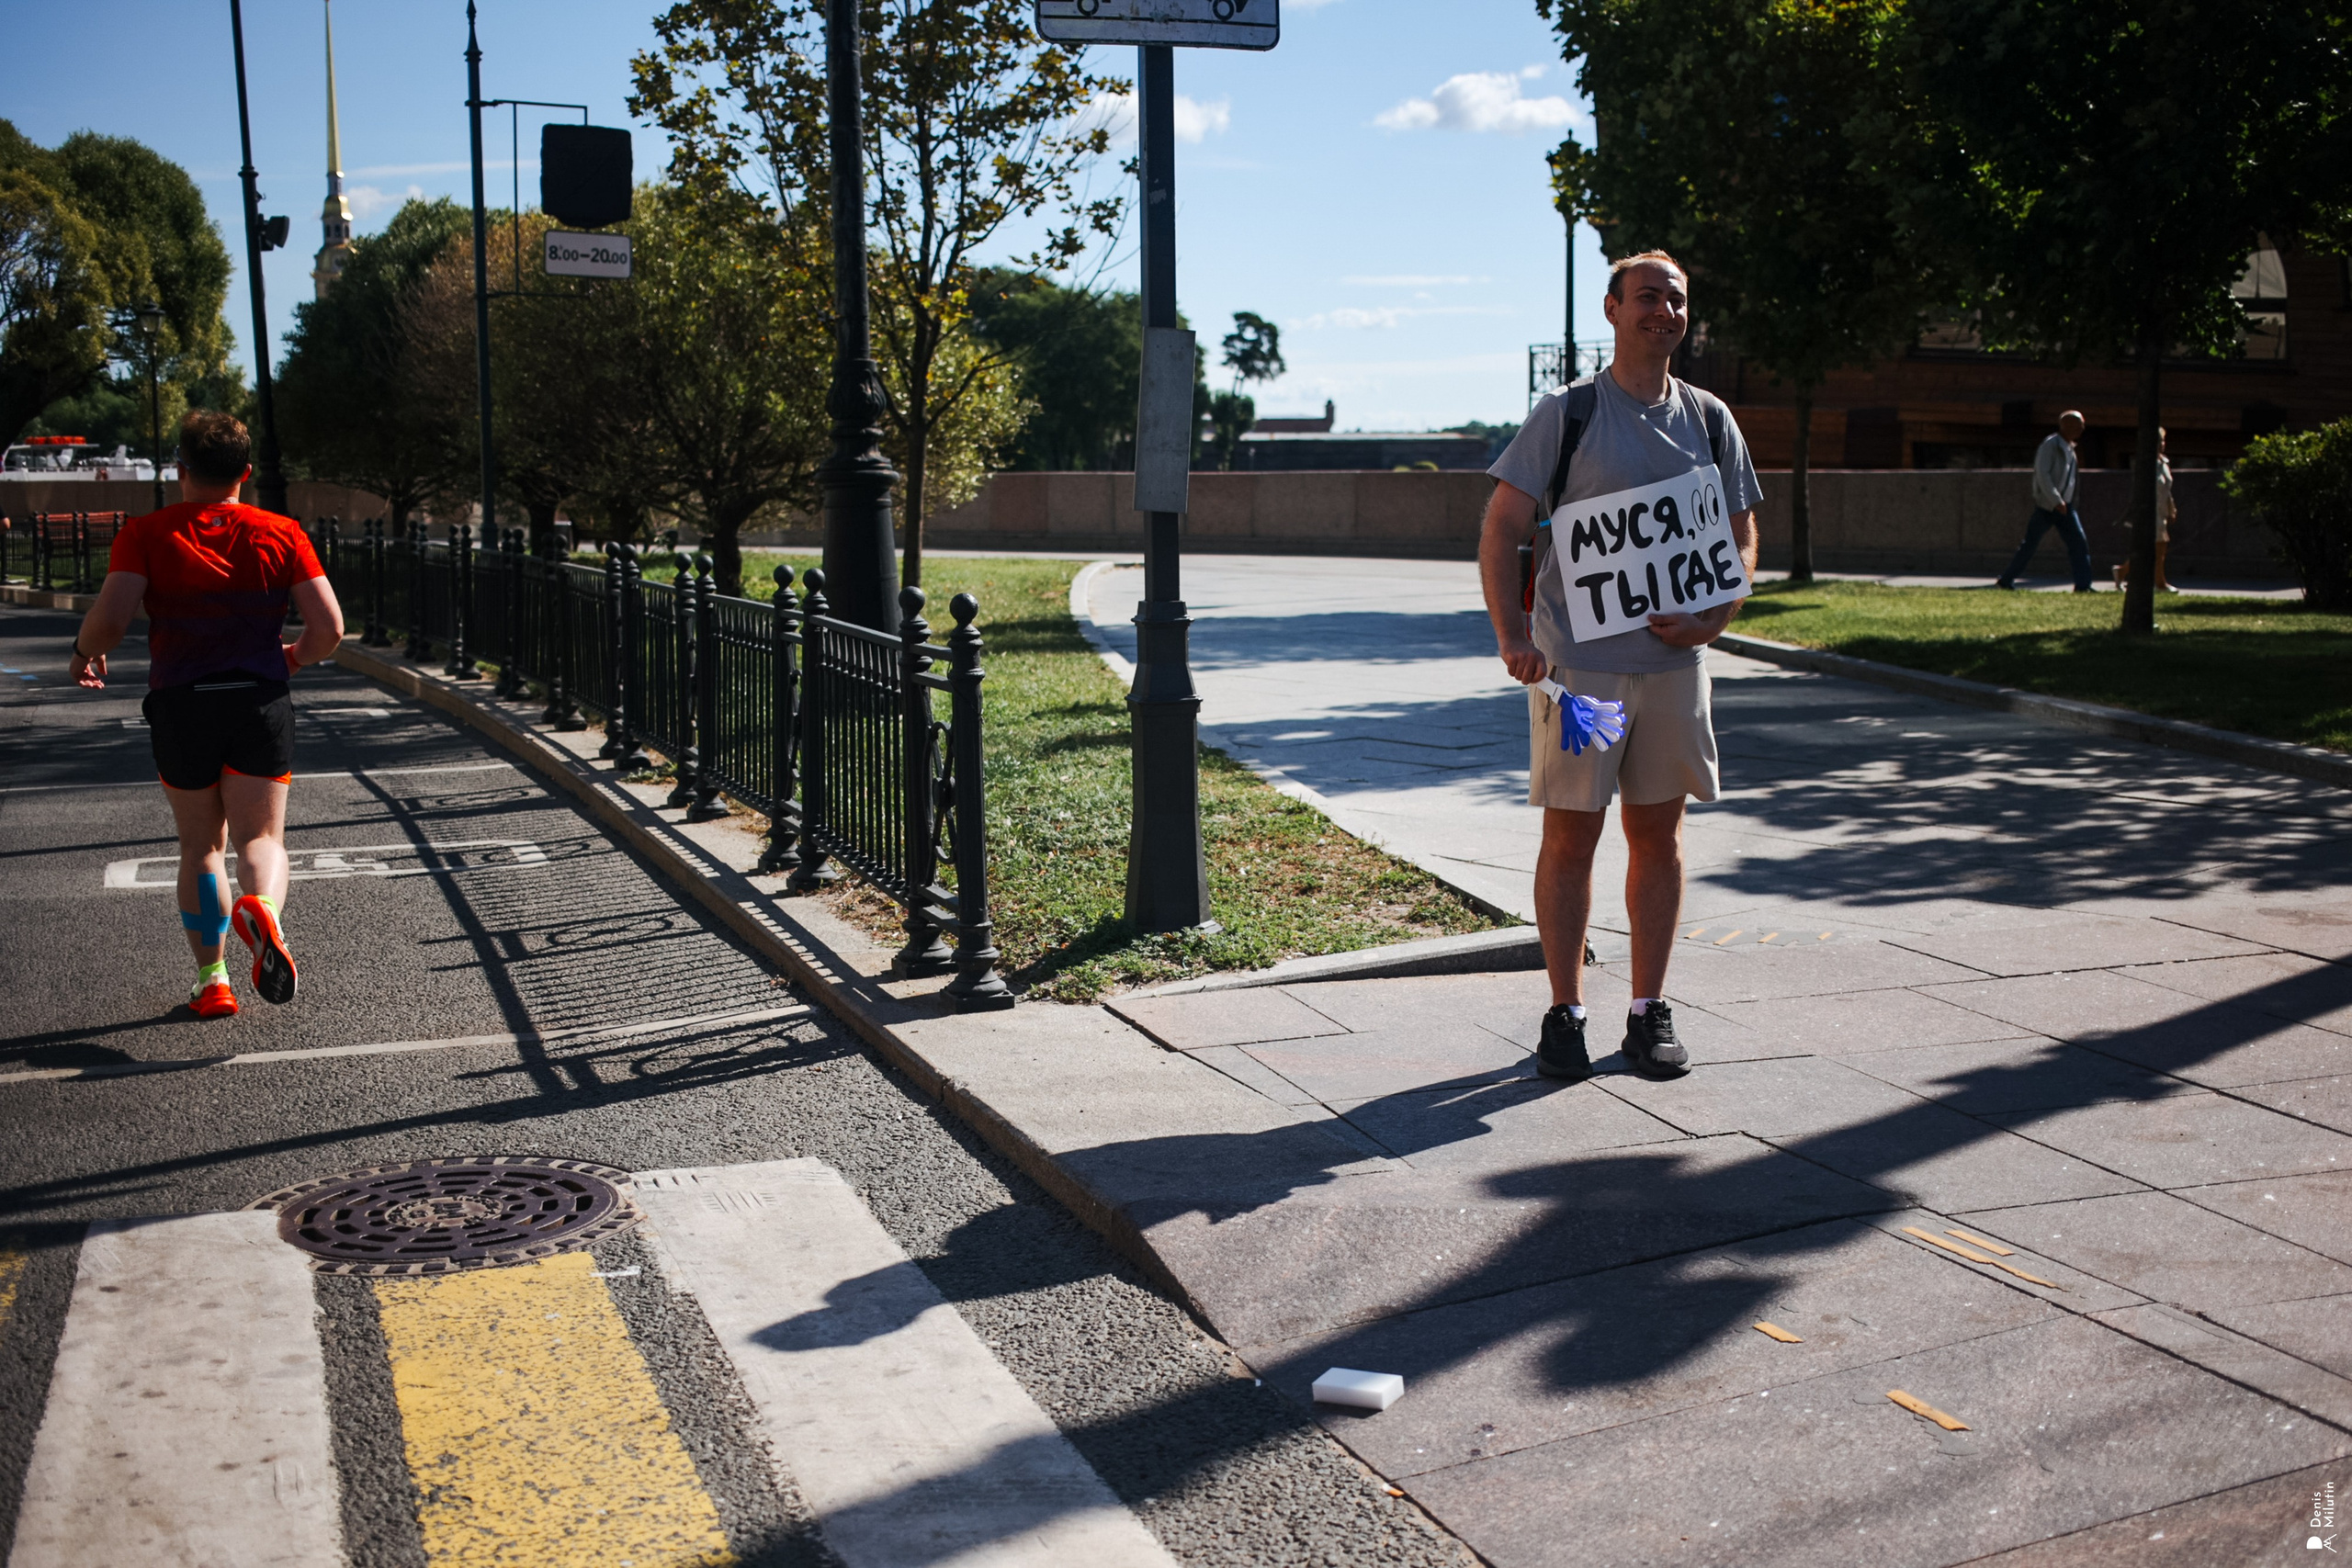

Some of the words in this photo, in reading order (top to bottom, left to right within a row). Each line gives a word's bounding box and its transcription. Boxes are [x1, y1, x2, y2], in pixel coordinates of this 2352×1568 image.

[1571, 496, 1696, 563] МУСЯ,
[1575, 562, 1660, 625] ТЫ
[1668, 540, 1742, 604] ГДЕ
